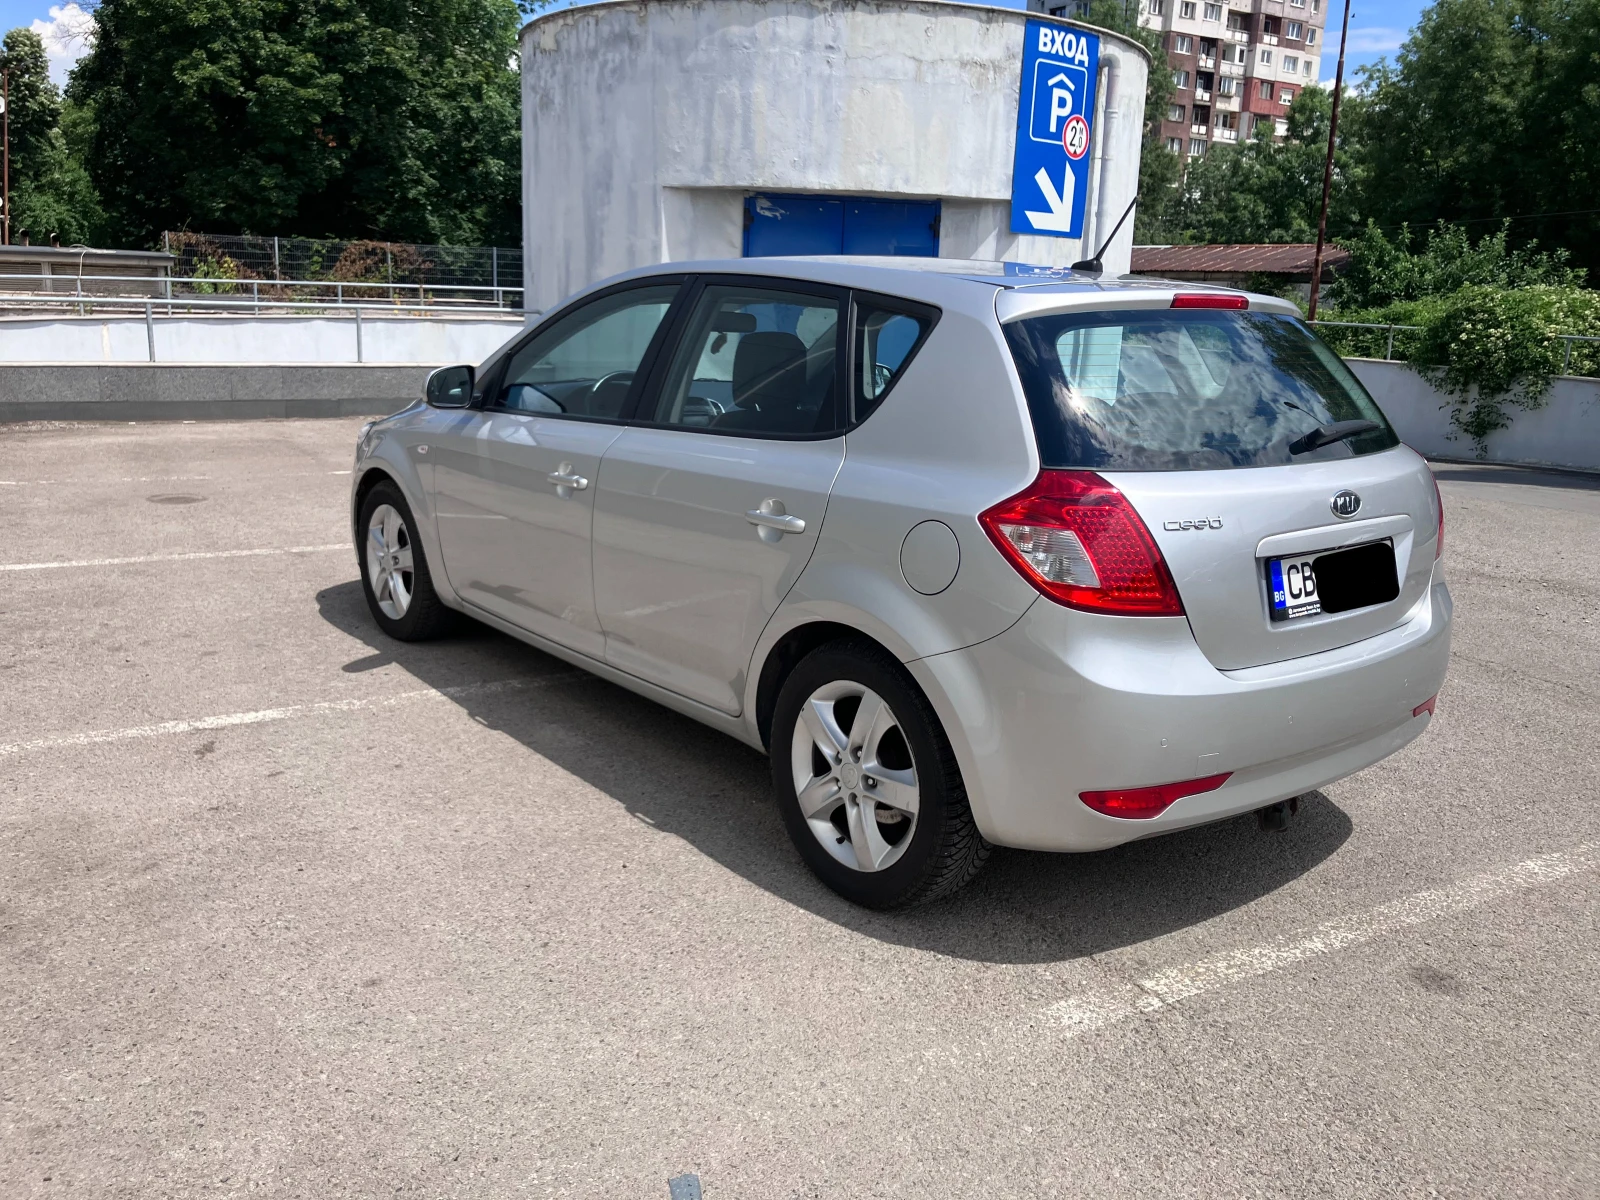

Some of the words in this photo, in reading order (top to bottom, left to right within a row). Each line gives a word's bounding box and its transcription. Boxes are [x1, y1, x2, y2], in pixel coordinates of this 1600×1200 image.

[1038, 26, 1089, 67] ВХОД
[1049, 87, 1073, 133] P
[1274, 590, 1285, 603] BG
